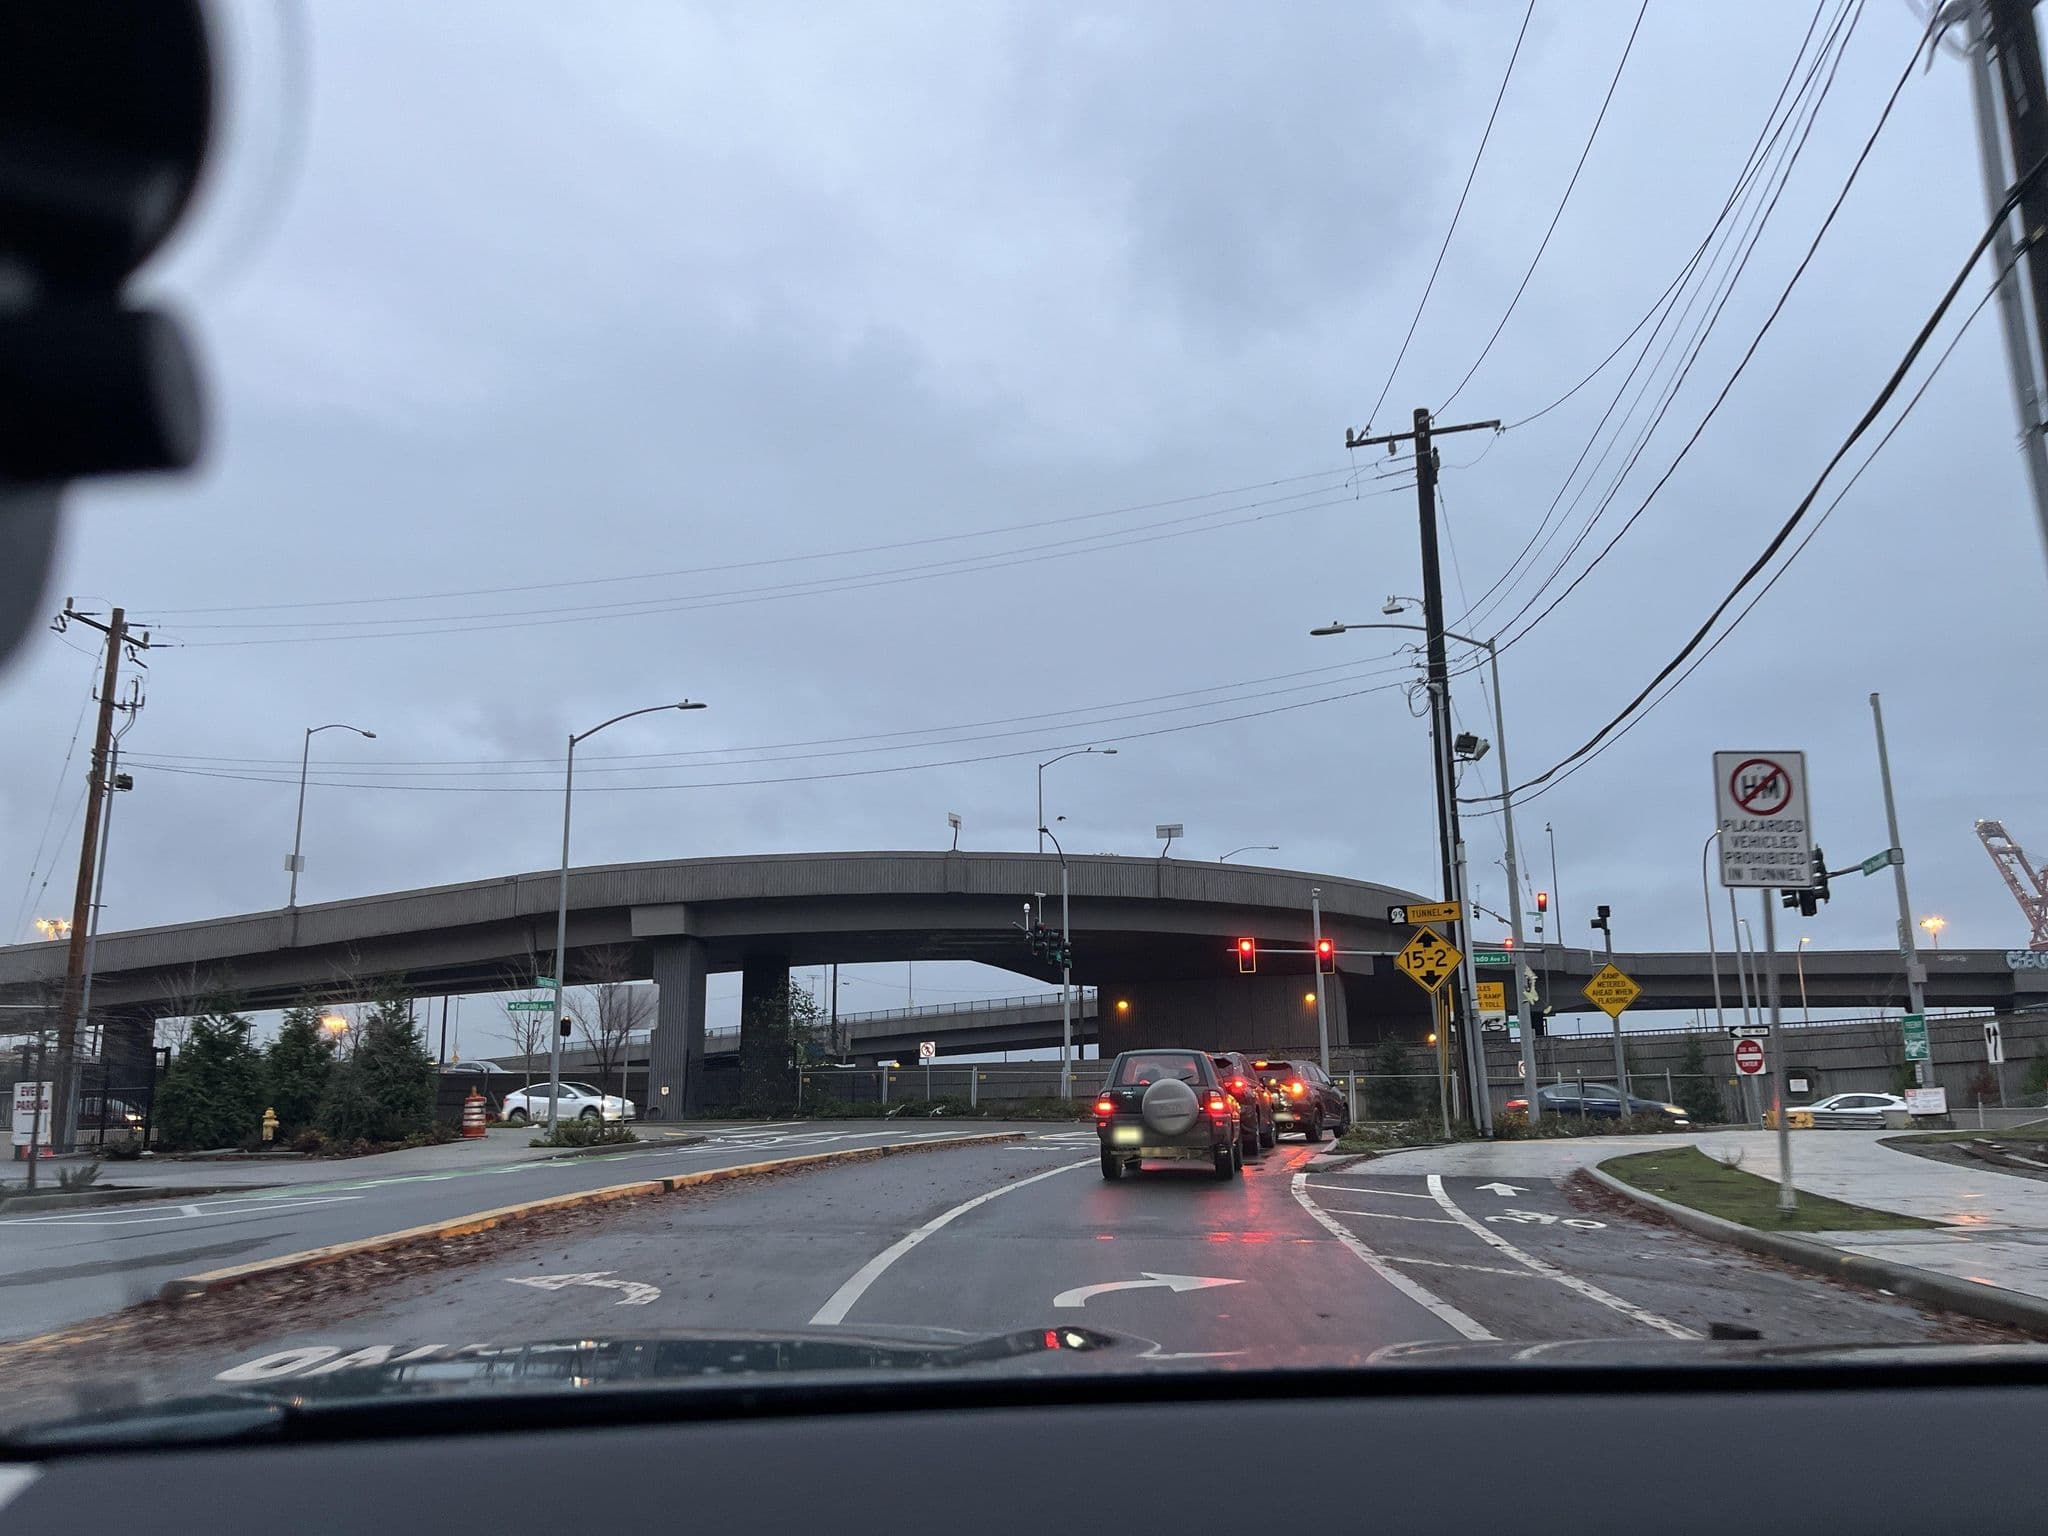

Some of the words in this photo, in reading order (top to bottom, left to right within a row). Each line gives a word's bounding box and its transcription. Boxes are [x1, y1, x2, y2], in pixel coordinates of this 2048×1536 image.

[1723, 820, 1803, 833] PLACARDED
[1731, 835, 1799, 849] VEHICLES
[1724, 852, 1806, 865] PROHIBITED
[1728, 868, 1743, 880] IN
[1749, 867, 1806, 881] TUNNEL
[1411, 908, 1442, 918] TUNNEL
[21, 1086, 45, 1096] EVET
